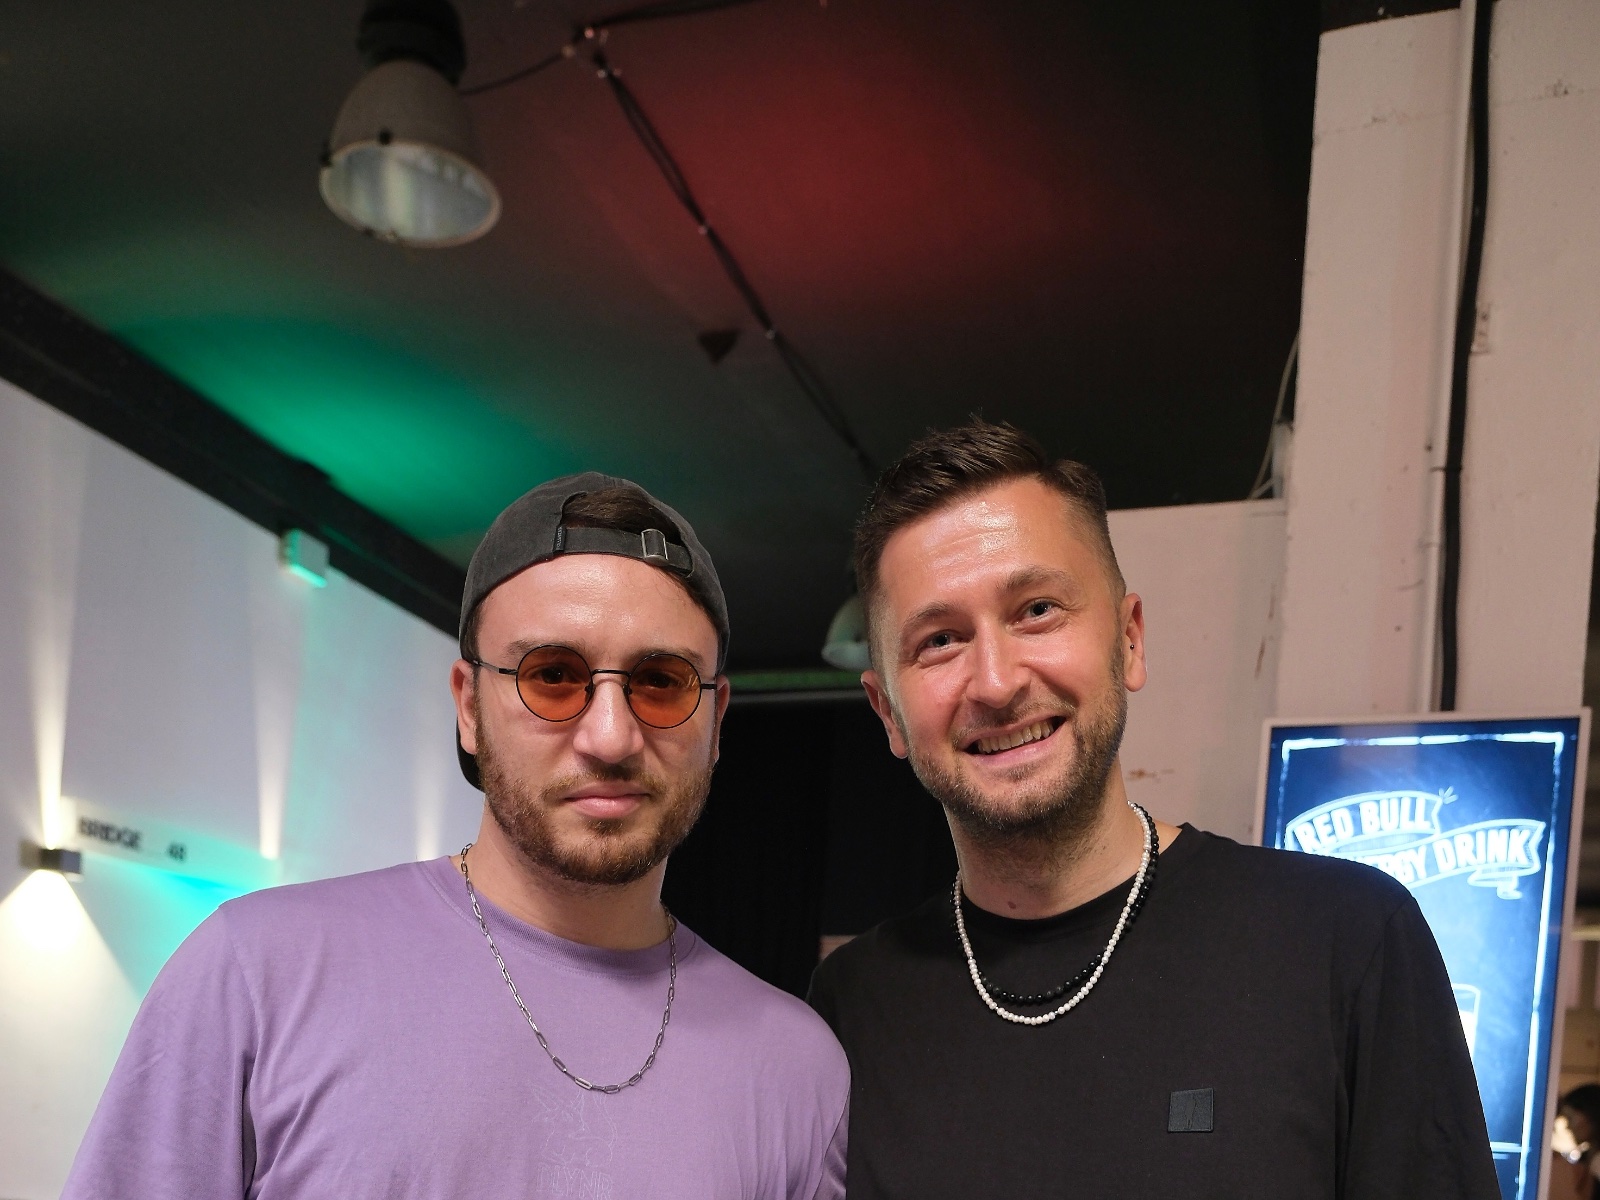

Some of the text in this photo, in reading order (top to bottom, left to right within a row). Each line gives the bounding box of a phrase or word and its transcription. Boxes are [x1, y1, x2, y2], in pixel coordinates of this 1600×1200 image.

[1295, 796, 1432, 854] RED BULL
[1433, 828, 1530, 873] DRINK
